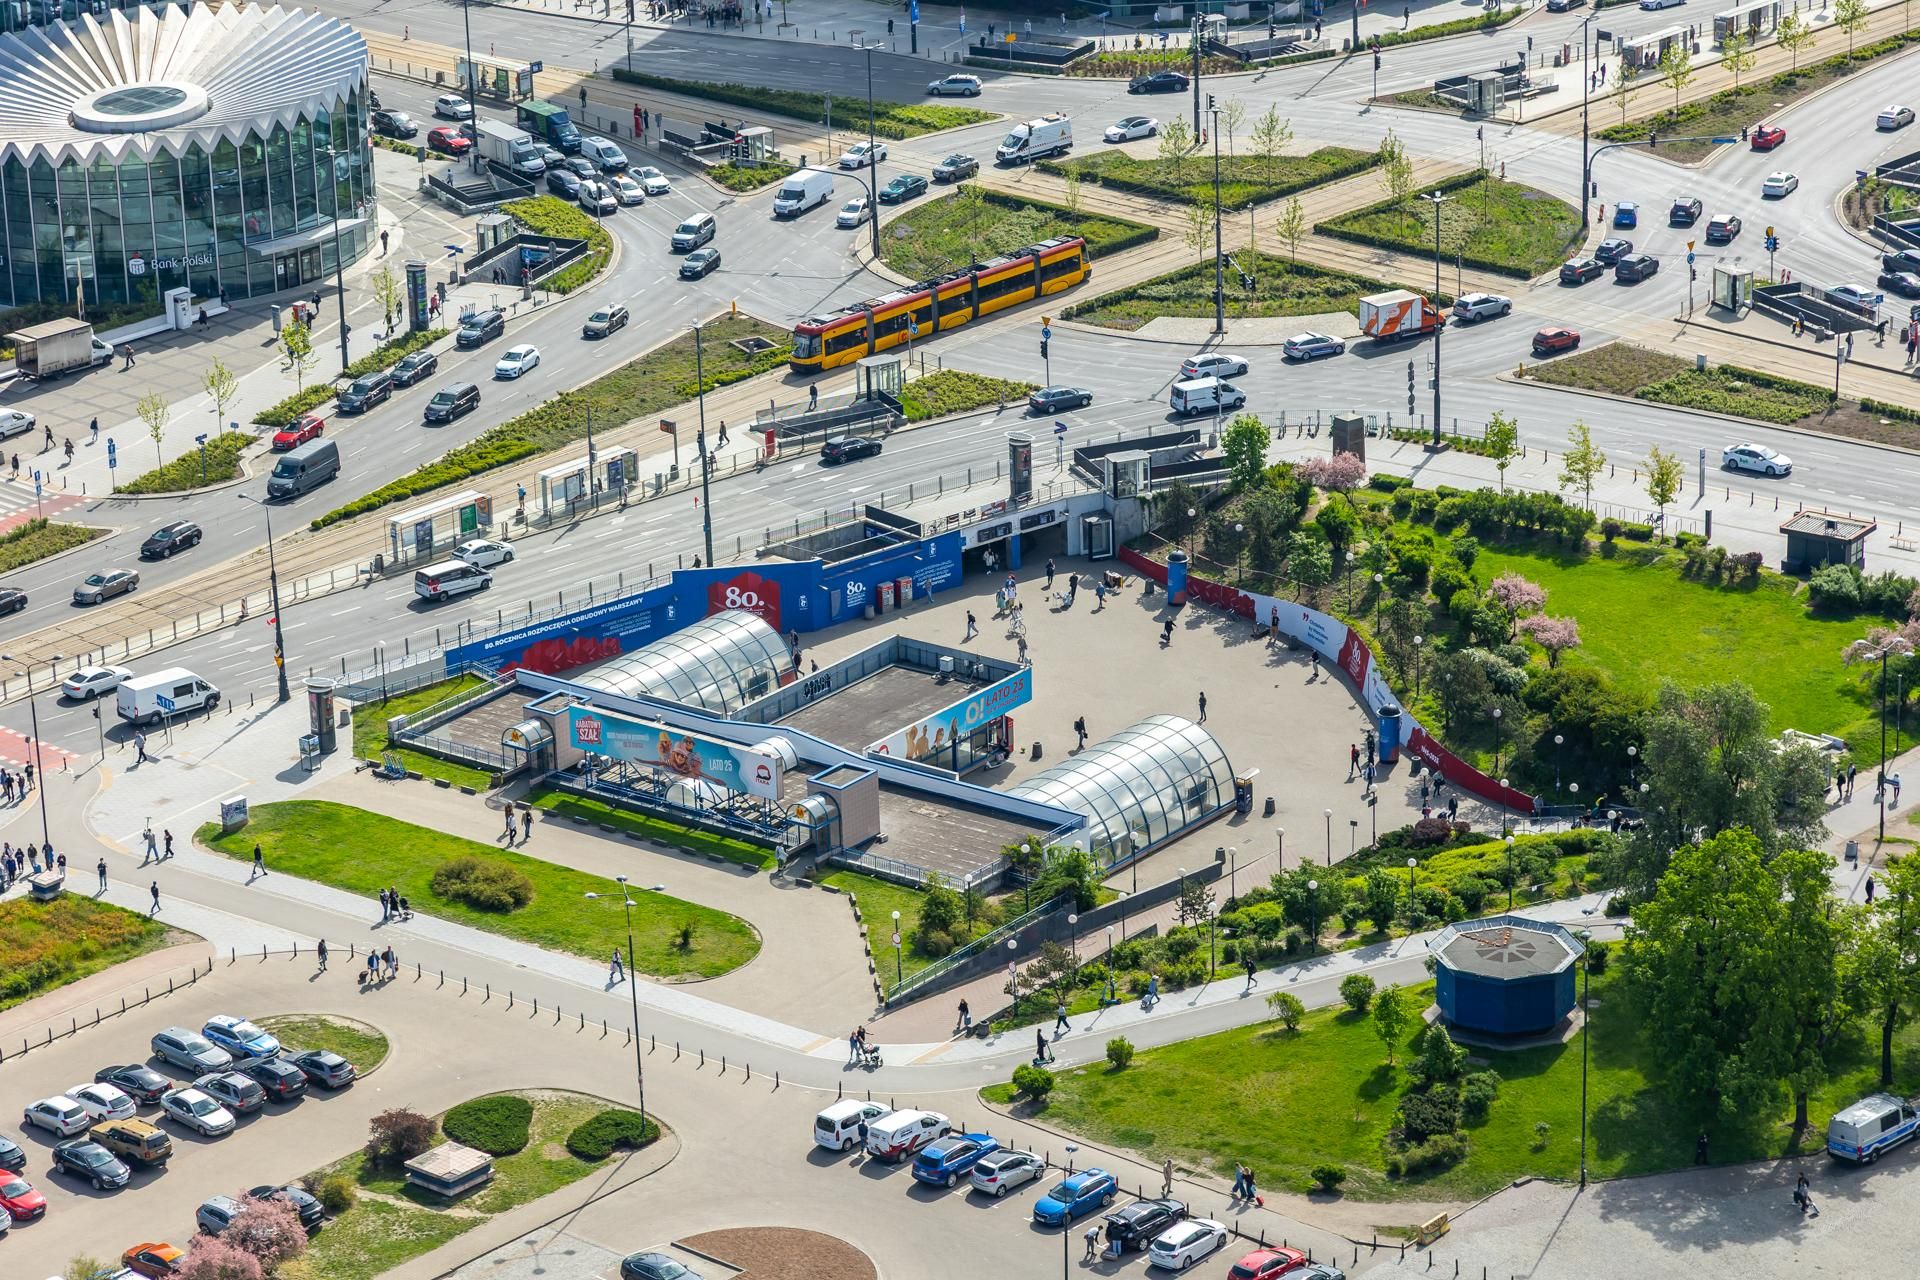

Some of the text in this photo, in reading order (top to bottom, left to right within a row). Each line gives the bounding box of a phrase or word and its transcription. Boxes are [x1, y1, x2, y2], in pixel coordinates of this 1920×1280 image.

[151, 253, 213, 270] Bank Polski
[847, 581, 866, 595] 80.
[725, 586, 765, 609] 80.
[494, 632, 528, 647] ROCZNICA
[527, 618, 571, 637] ROZPOCZĘCIA
[571, 607, 608, 624] ODBUDOWY
[607, 597, 644, 613] WARSZAWY
[965, 697, 985, 725] O!
[985, 685, 1011, 707] LATO
[1012, 678, 1024, 694] 25
[575, 719, 601, 729] RABATOWY
[579, 728, 599, 741] SZAŁ
[709, 759, 733, 772] LATO 25
[755, 778, 770, 786] ITAKA
